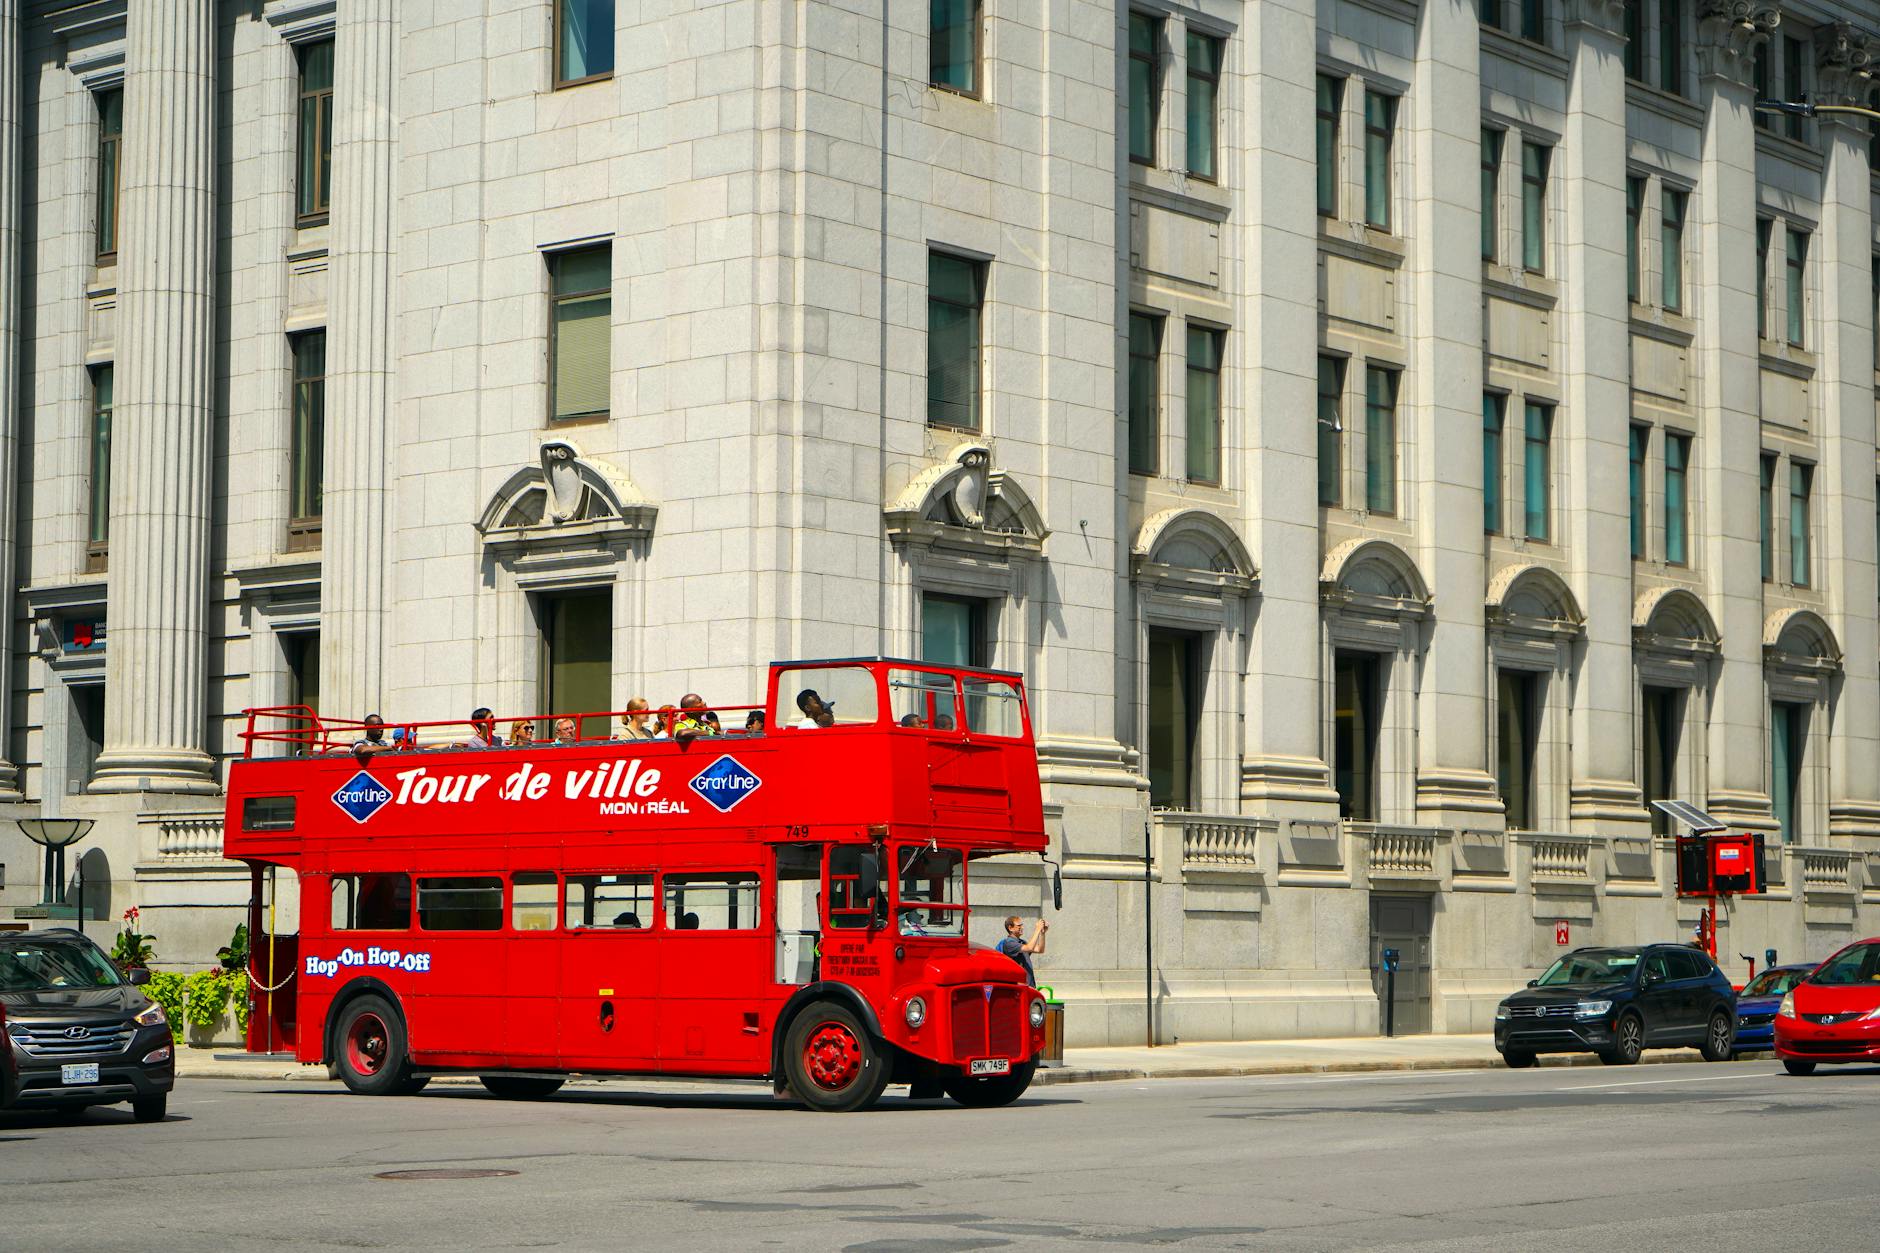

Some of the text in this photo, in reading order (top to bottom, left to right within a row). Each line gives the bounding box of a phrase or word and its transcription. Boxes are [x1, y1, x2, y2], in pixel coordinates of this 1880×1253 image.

[395, 759, 660, 805] Tour de ville
[786, 825, 809, 838] 749
[972, 1060, 1008, 1071] SMK 749F
[84, 1068, 98, 1079] 296
